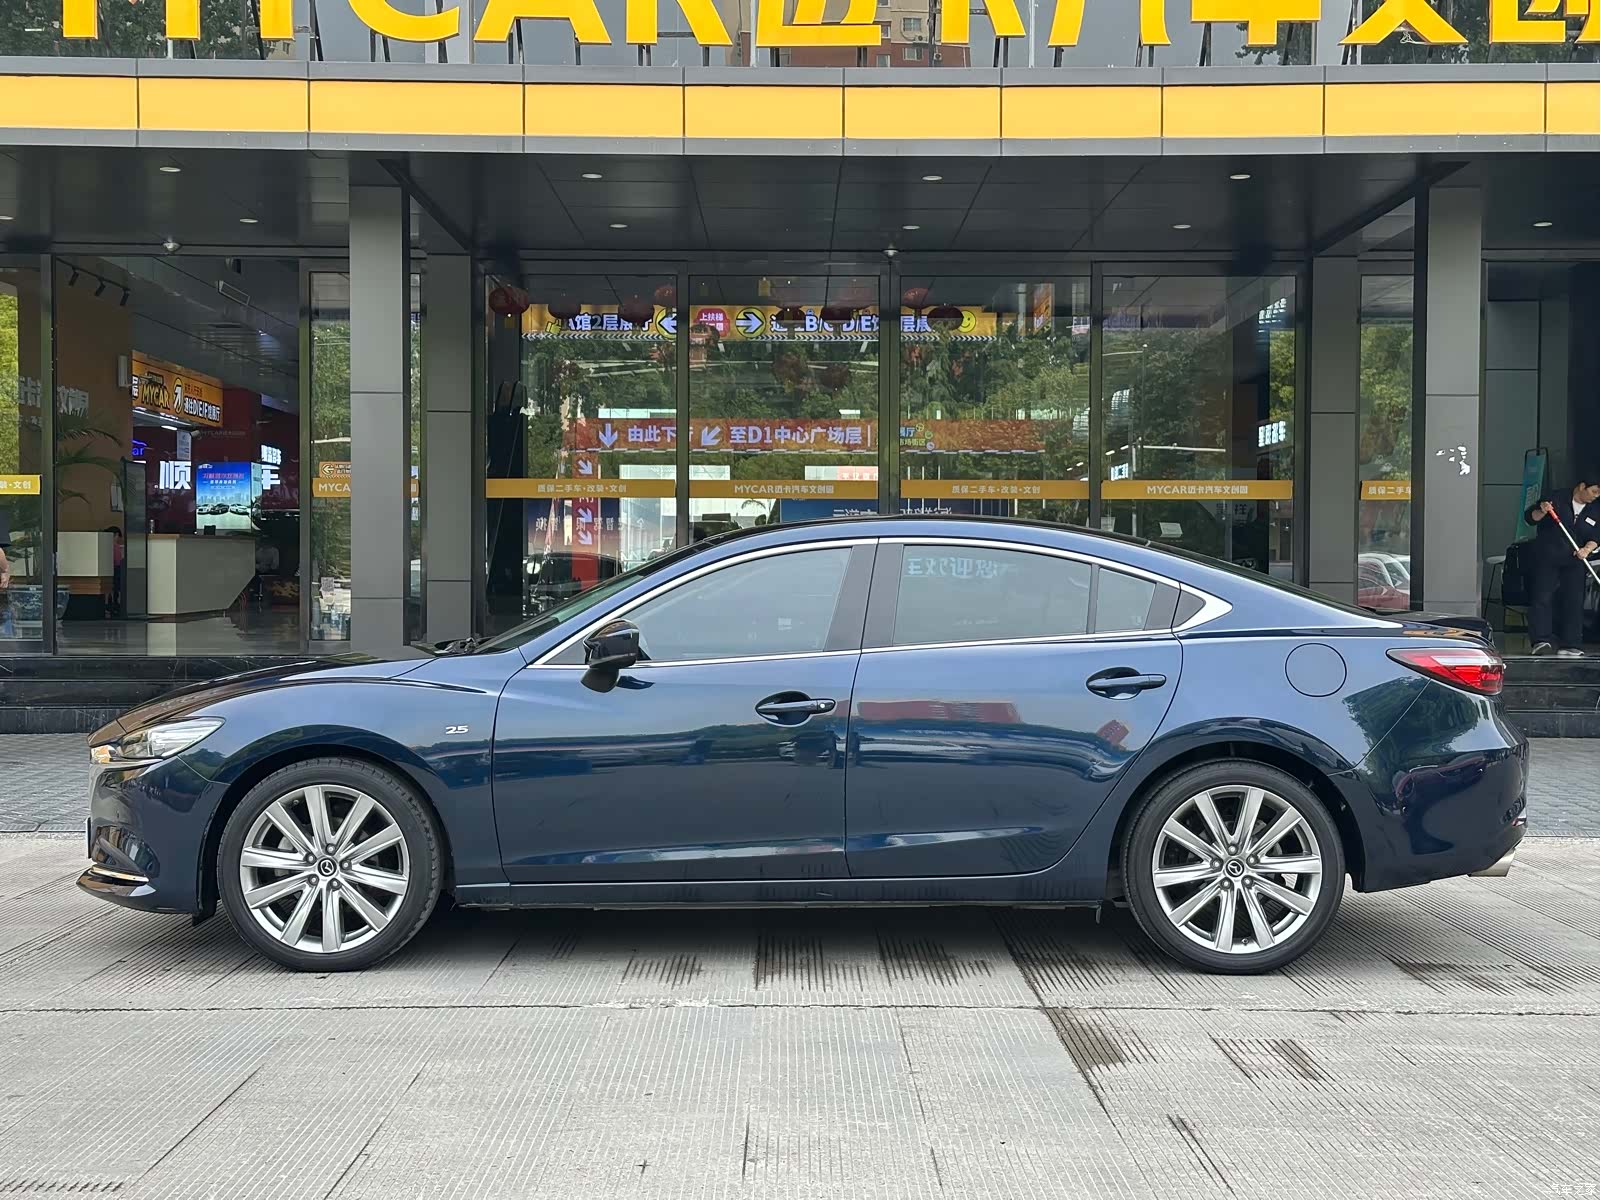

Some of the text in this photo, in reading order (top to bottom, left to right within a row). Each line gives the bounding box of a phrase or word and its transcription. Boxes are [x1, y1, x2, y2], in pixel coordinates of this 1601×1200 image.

[141, 383, 170, 410] MYCAR
[627, 425, 862, 444] 由此下 至D1中心广场层
[159, 460, 192, 490] 顺
[445, 725, 469, 735] 25
